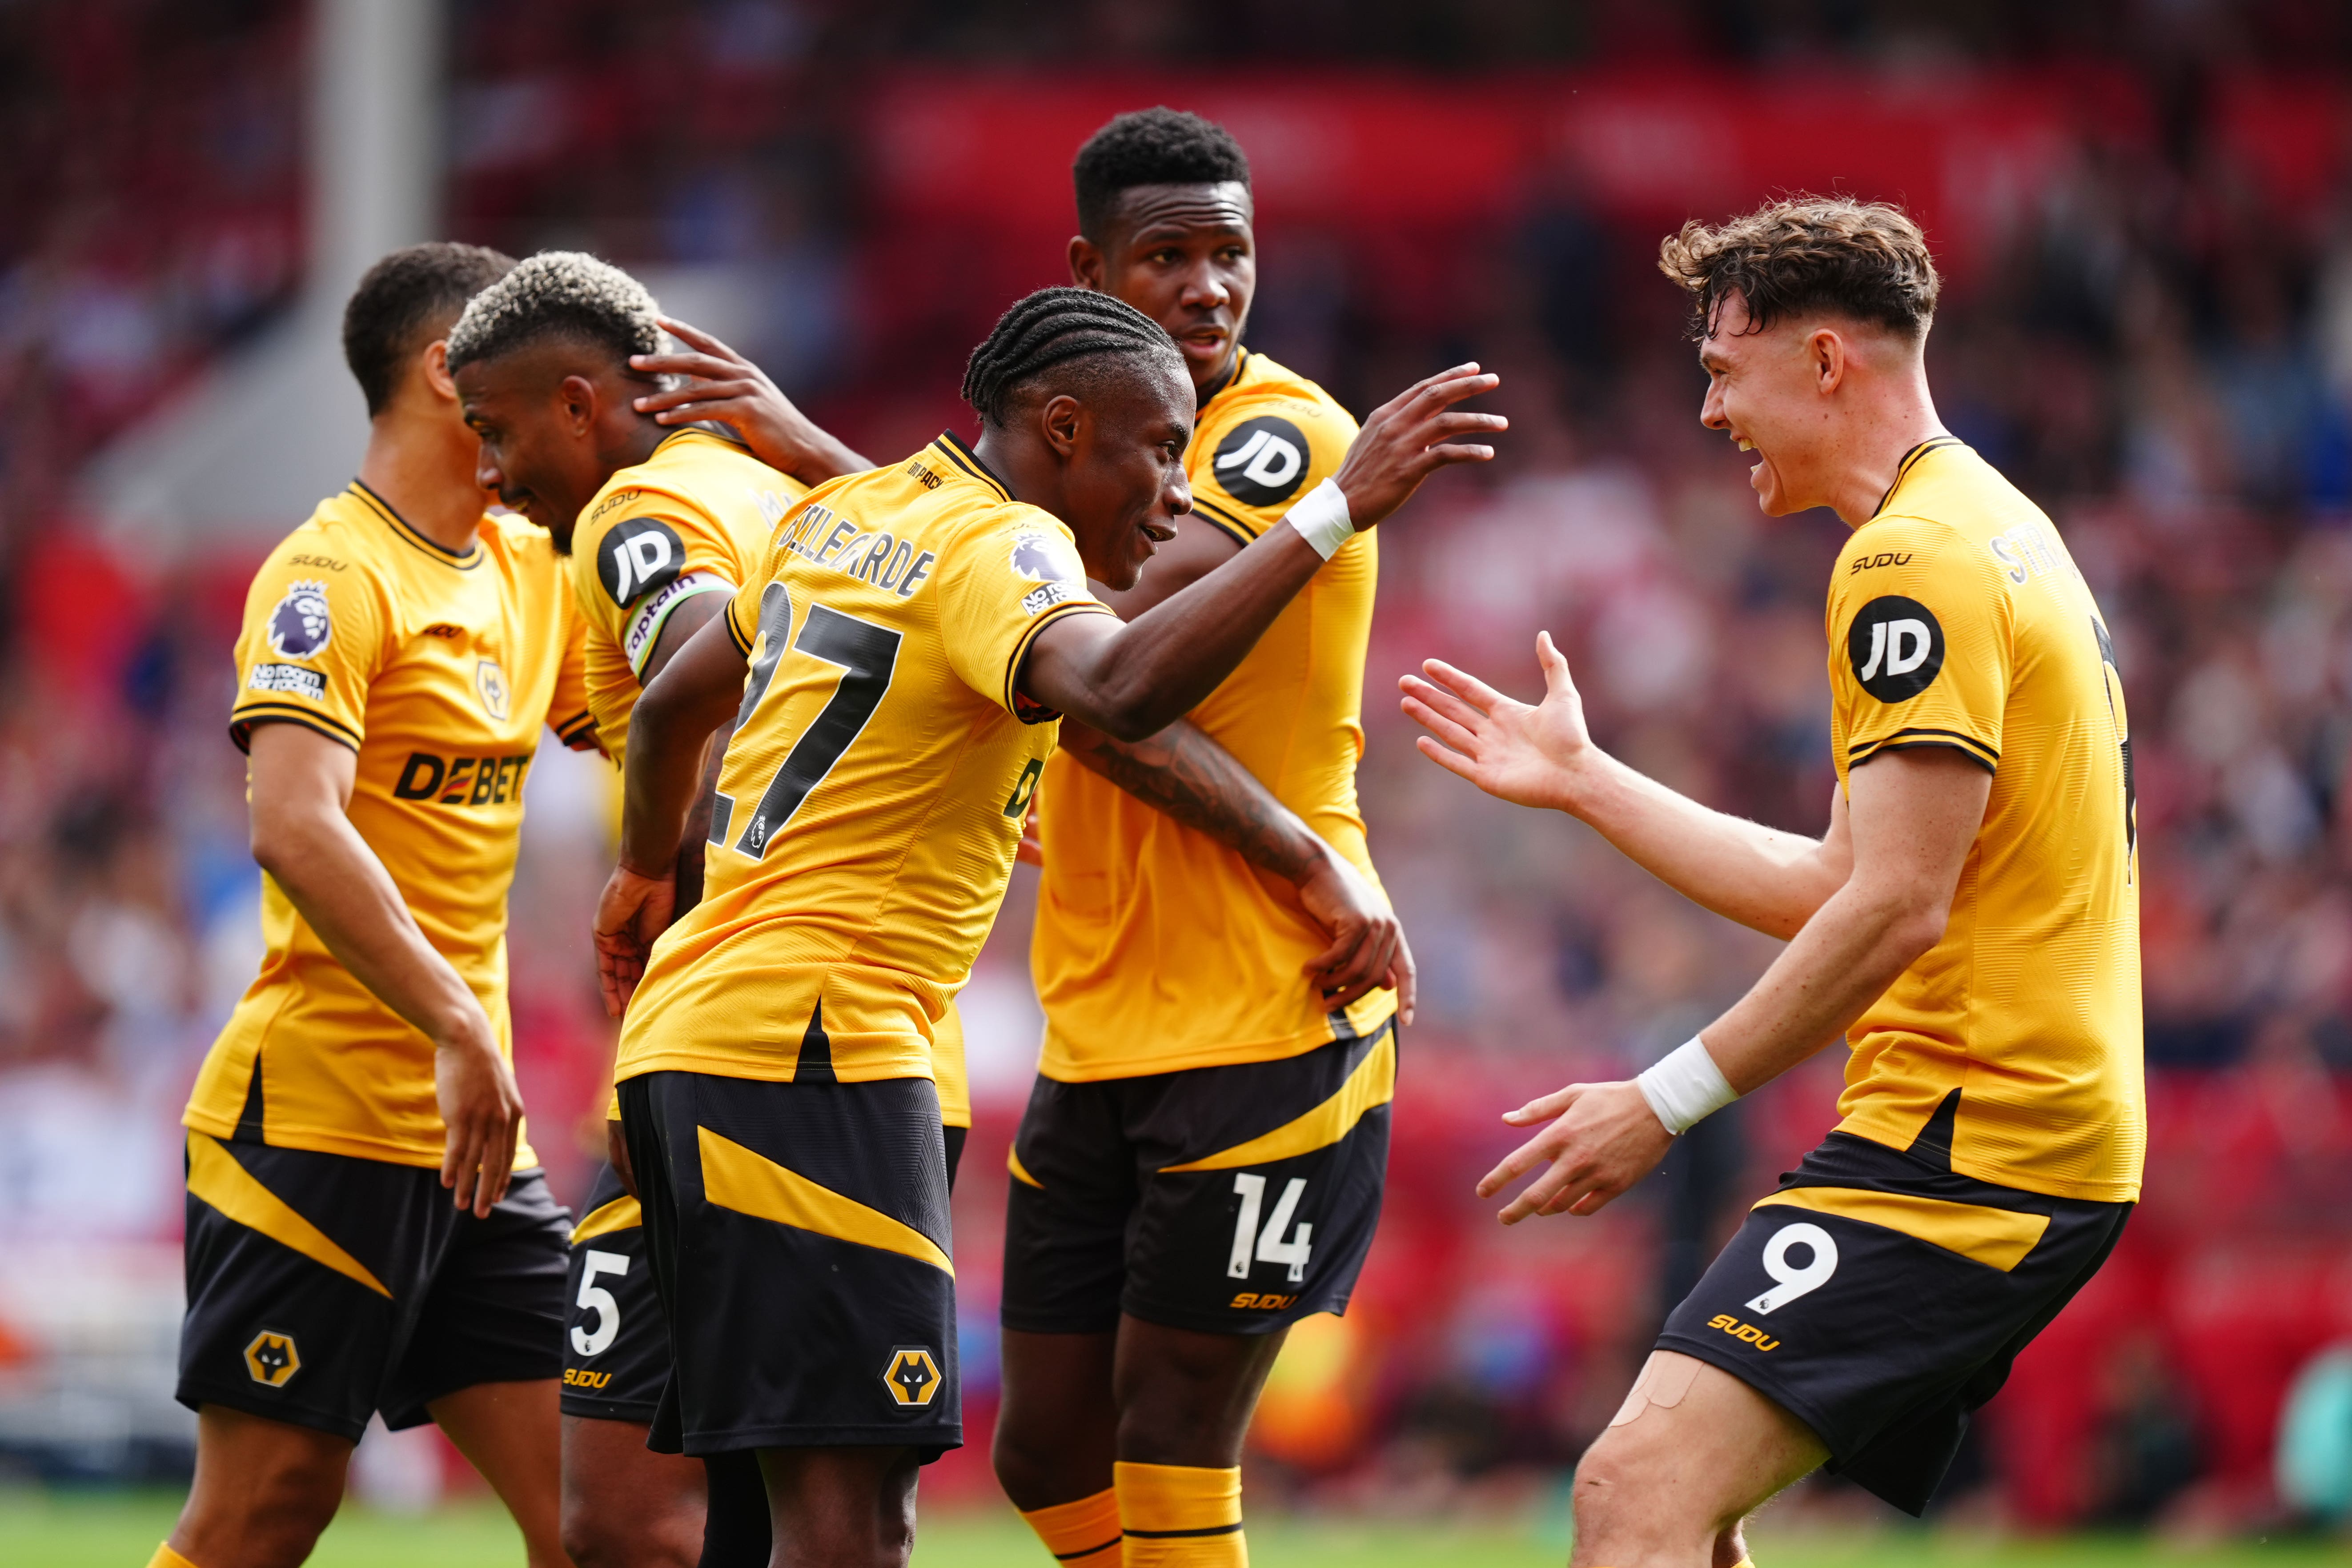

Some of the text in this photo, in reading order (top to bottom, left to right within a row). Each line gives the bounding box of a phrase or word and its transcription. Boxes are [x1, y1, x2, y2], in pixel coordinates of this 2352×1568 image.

[1217, 430, 1301, 487] JD
[590, 489, 642, 526] SUDU
[288, 554, 349, 572] SUDU
[614, 530, 672, 604] JD
[777, 503, 936, 598] BELLEGARDE
[1851, 553, 1912, 575] SUDU
[1021, 590, 1047, 610] No
[252, 663, 321, 687] No room
[1861, 618, 1931, 682] JD
[705, 581, 905, 862] 27
[393, 752, 530, 805] DEBET
[1227, 1172, 1313, 1282] 14
[1743, 1222, 1838, 1315] 9
[570, 1249, 630, 1356] 5
[1229, 1292, 1299, 1310] SUDU
[1706, 1314, 1780, 1352] SUDU
[562, 1367, 612, 1389] SUDU
